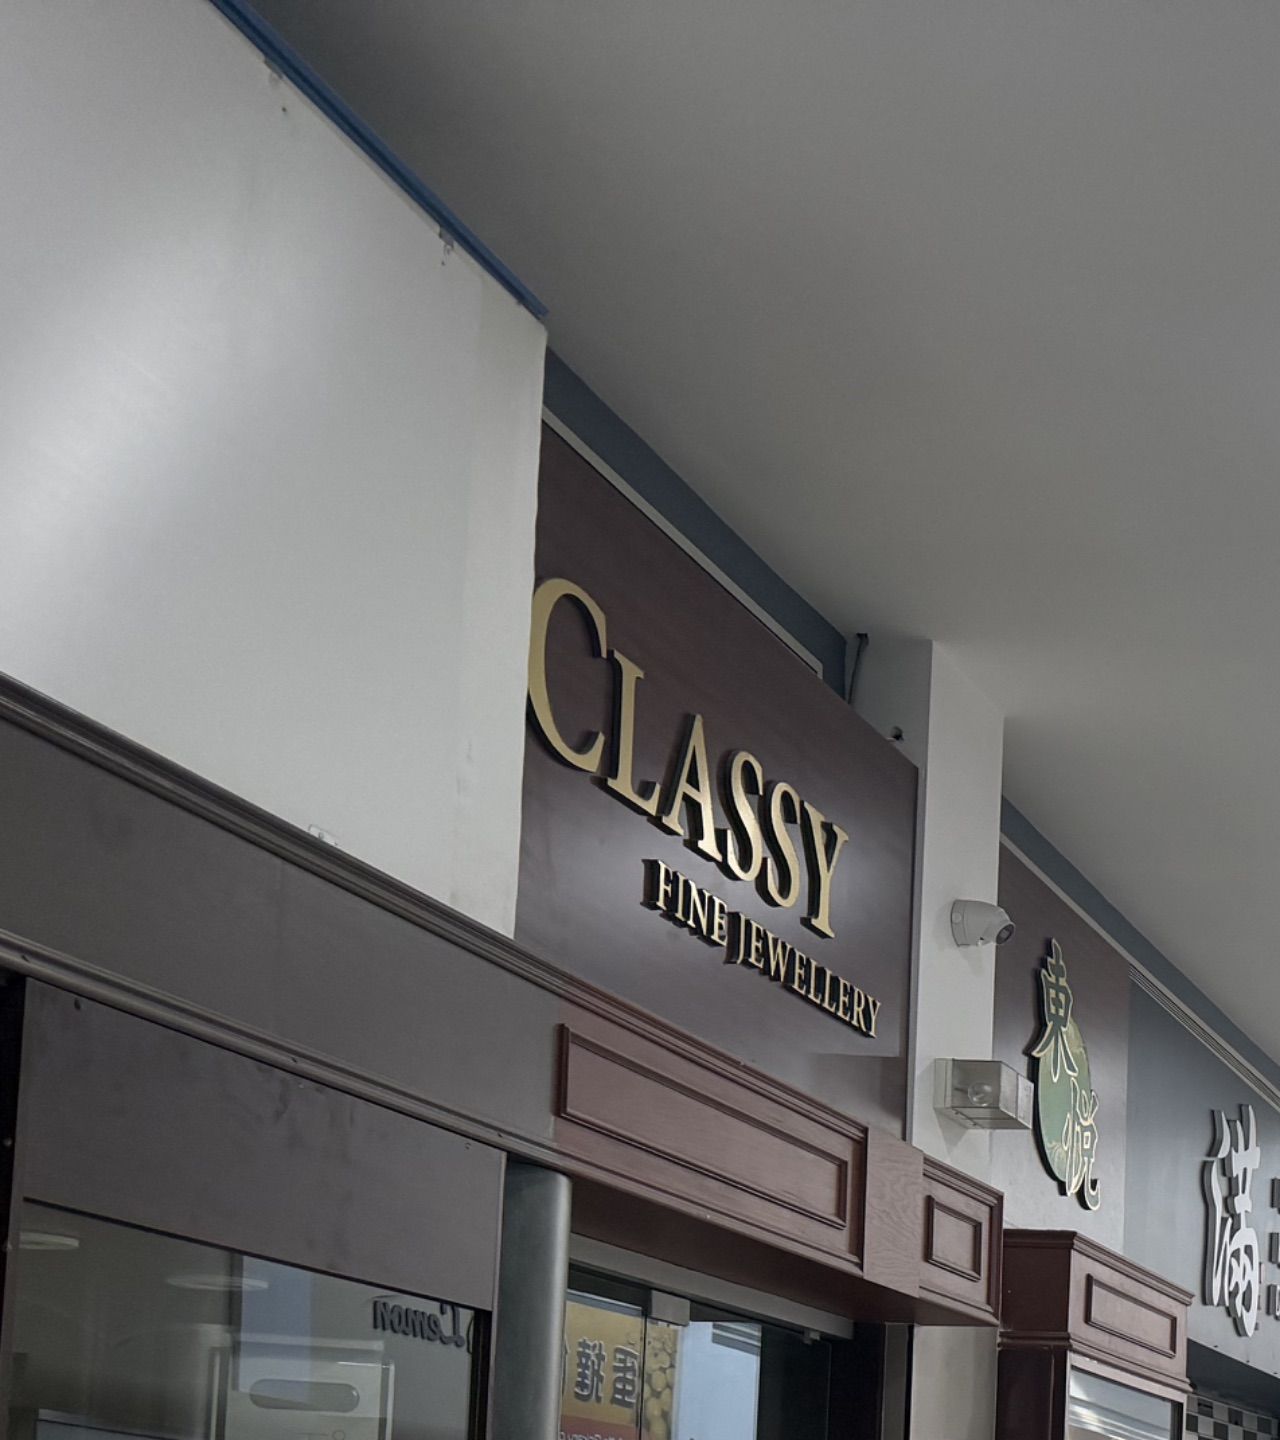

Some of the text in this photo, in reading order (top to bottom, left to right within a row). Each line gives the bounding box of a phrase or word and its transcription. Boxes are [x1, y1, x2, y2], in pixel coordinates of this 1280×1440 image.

[528, 578, 849, 938] CLASSY
[650, 859, 881, 1038] FINE JEWELLERY
